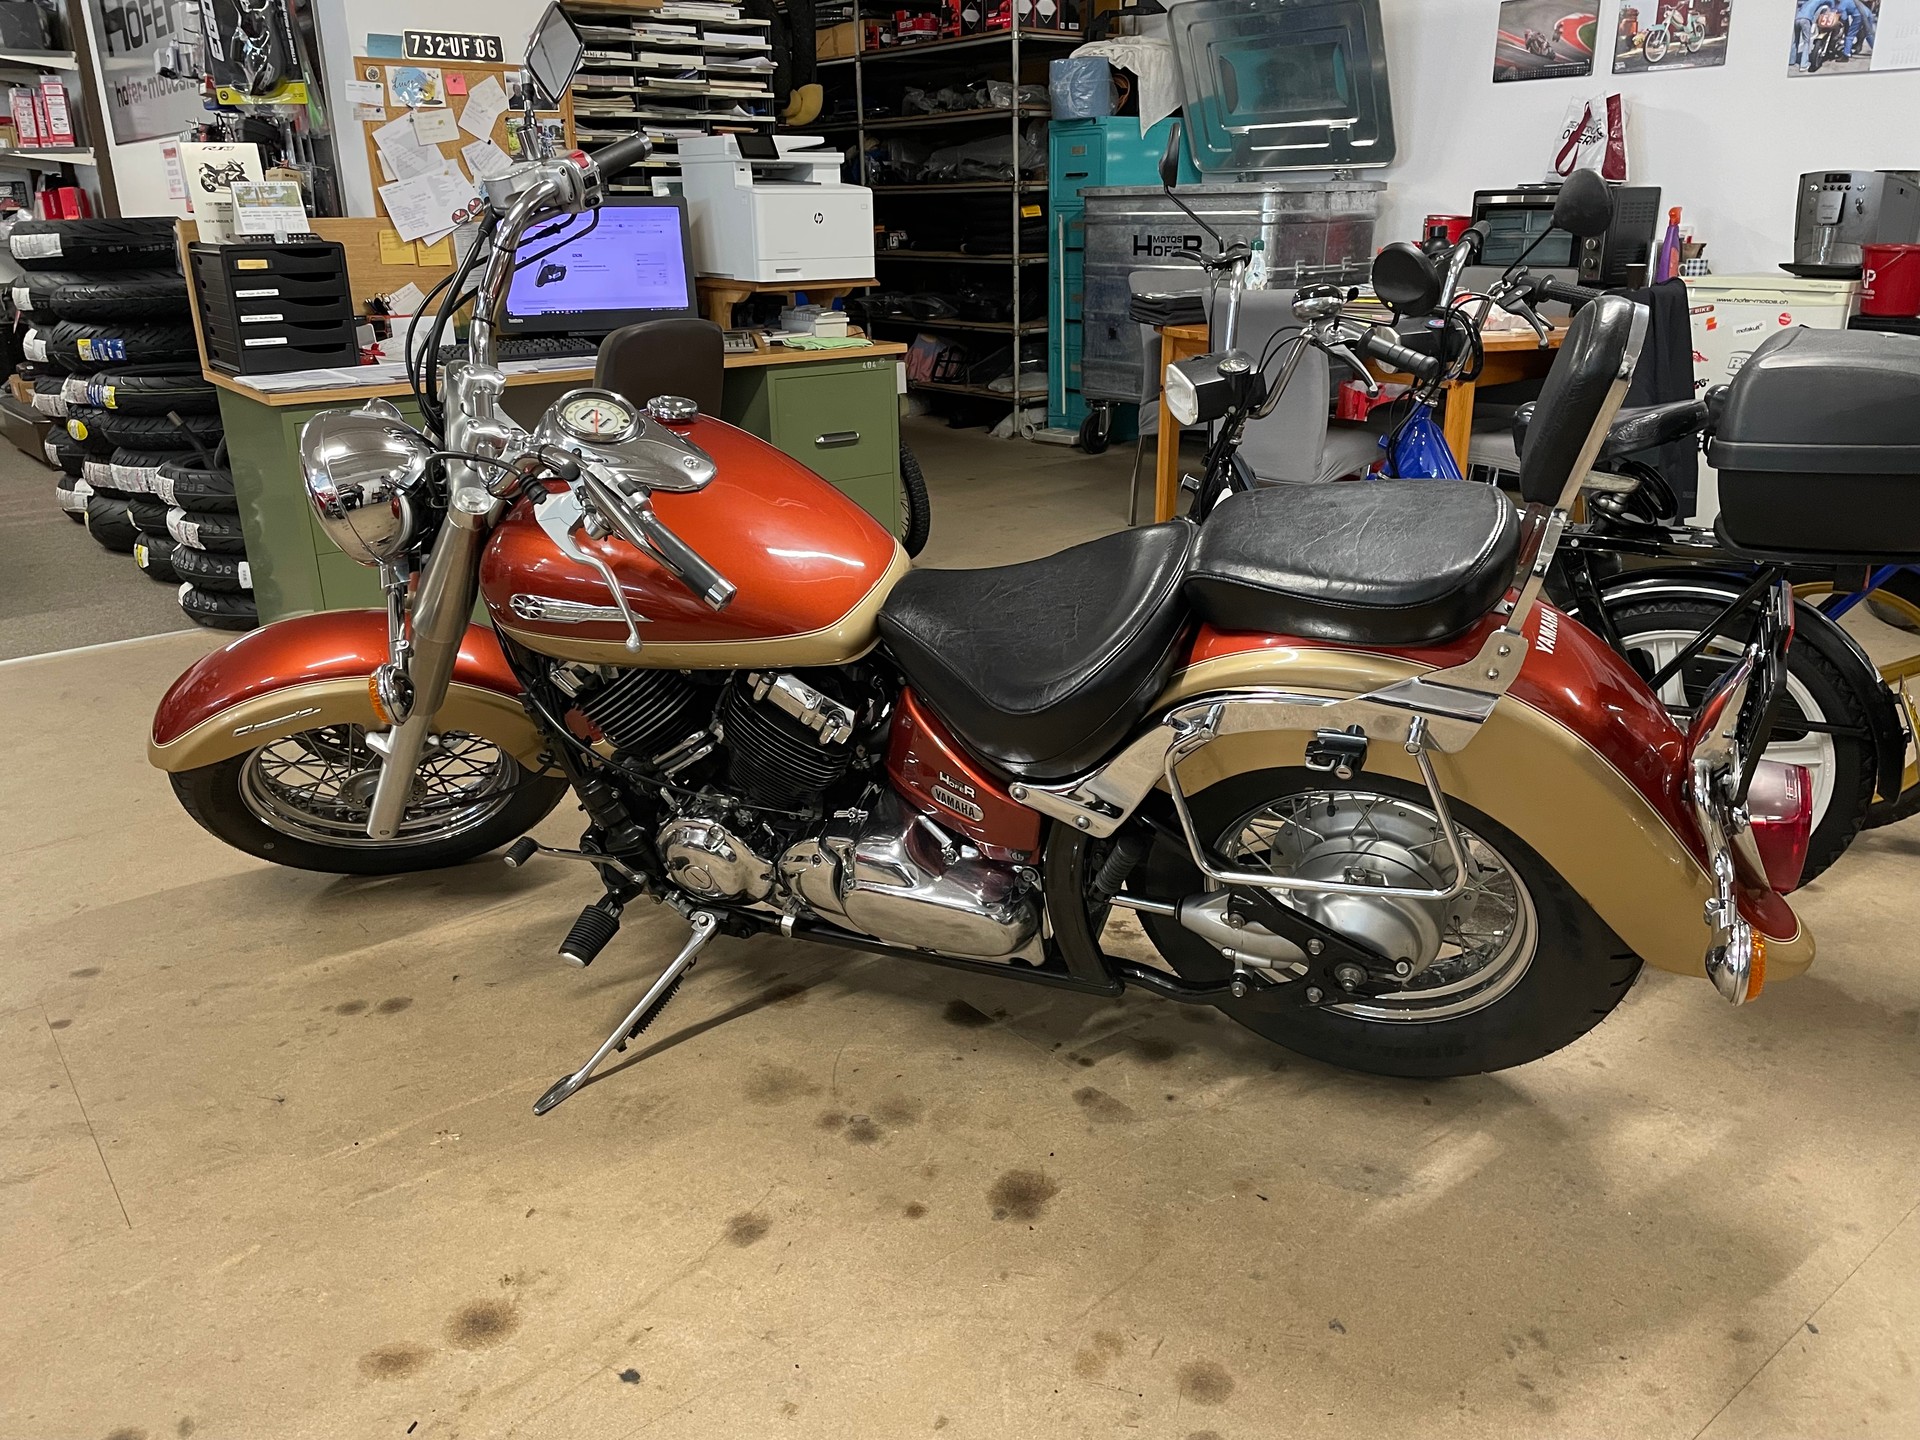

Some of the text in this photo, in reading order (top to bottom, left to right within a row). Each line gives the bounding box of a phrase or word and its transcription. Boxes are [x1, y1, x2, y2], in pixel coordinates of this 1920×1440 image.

[410, 34, 447, 57] 732
[449, 36, 470, 58] UF
[1153, 235, 1183, 244] MOTOS
[1535, 607, 1558, 655] YAMAHA
[935, 788, 975, 818] YAMAHA
